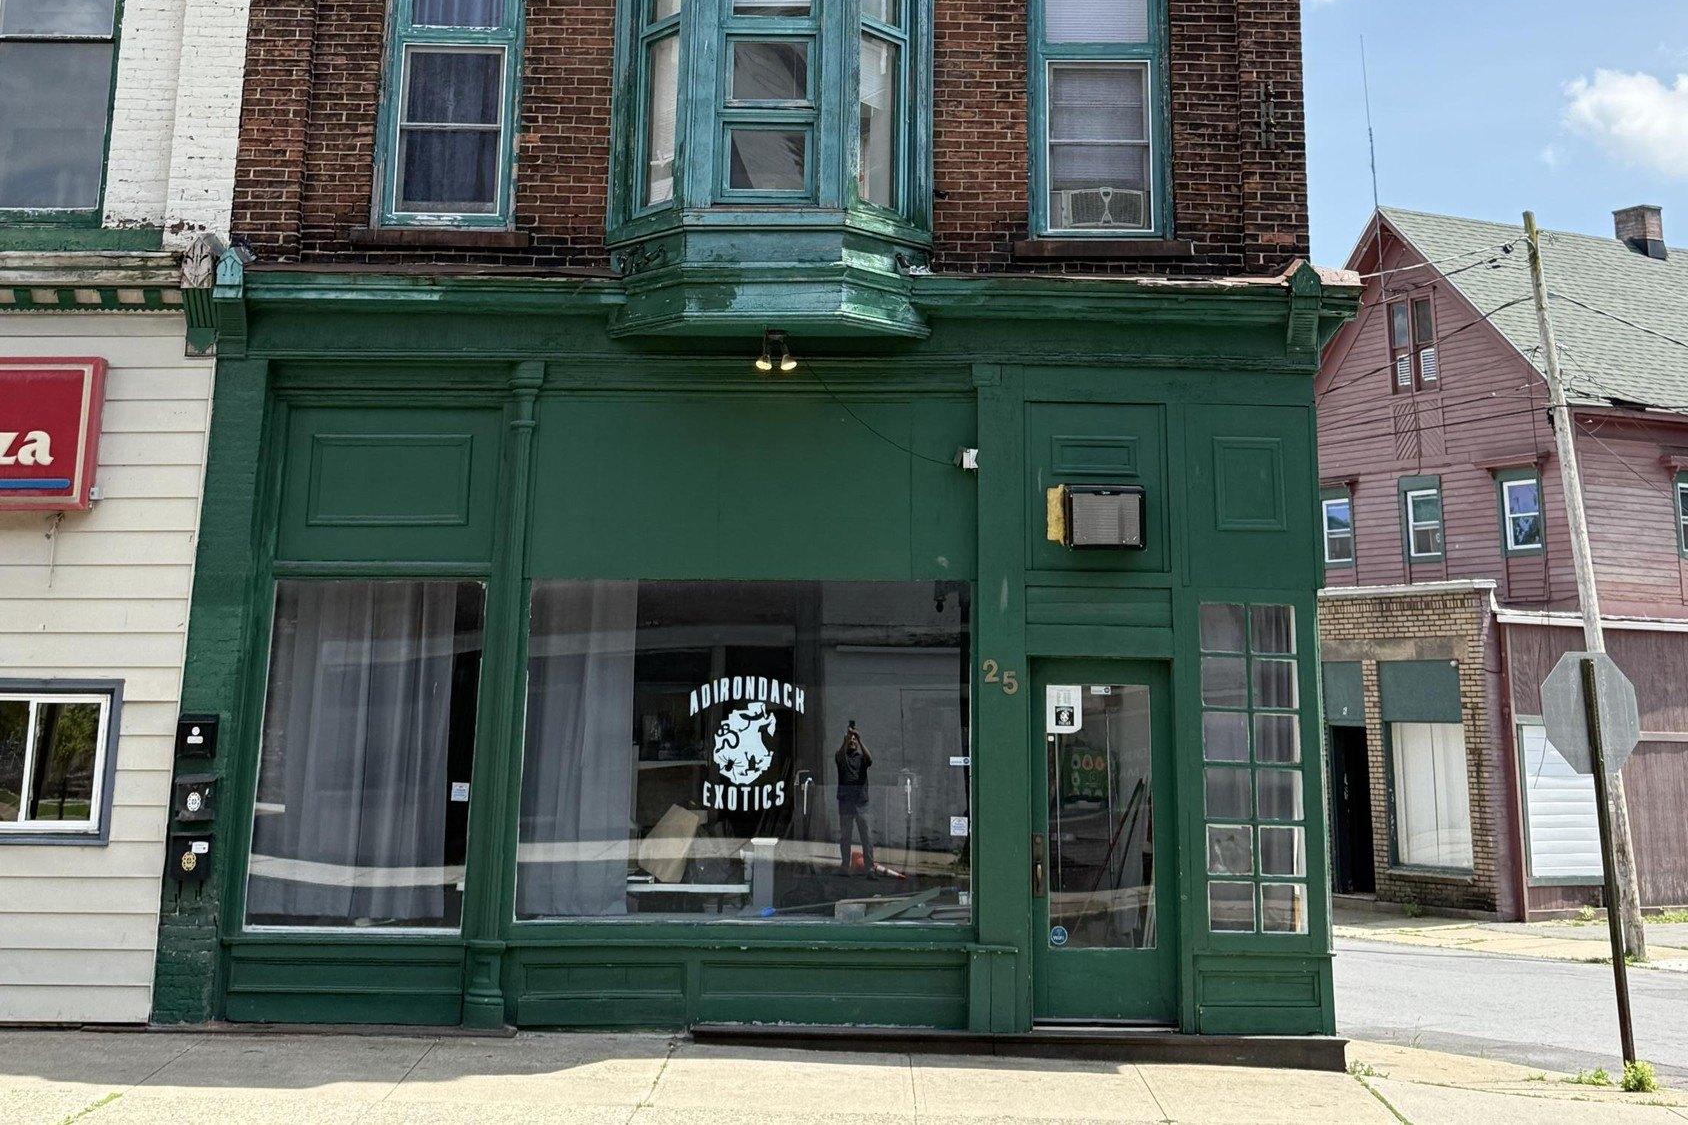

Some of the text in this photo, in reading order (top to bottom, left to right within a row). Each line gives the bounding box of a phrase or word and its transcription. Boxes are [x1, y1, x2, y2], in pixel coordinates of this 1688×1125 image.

[982, 659, 1019, 695] 25
[689, 676, 805, 717] ADIRONDACK
[702, 780, 785, 812] EXOTICS
